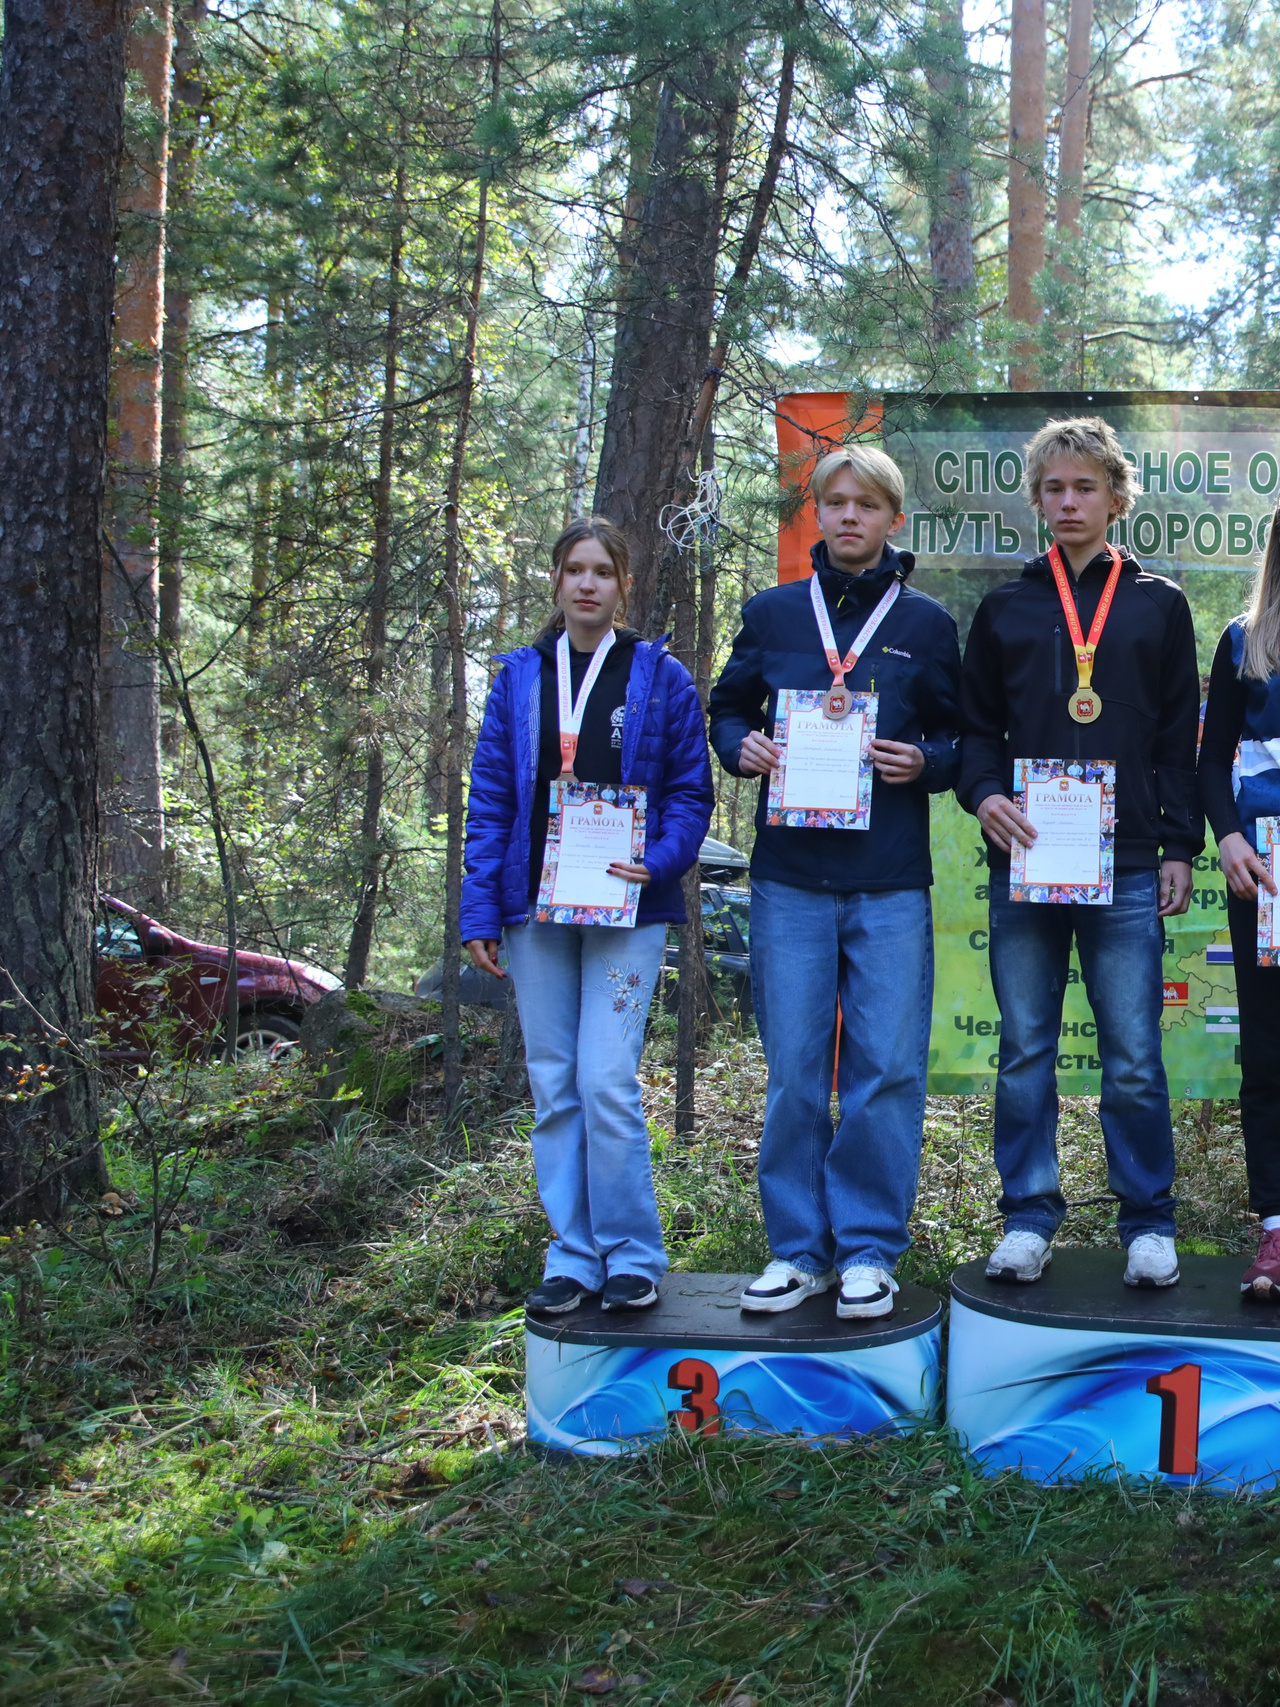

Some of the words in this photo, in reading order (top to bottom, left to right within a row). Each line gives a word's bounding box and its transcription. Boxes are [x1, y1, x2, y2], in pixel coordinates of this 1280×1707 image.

[933, 450, 1231, 495] СПОНОЕ
[911, 511, 1021, 555] ПУТЬ
[797, 720, 854, 731] ГРАМОТА
[1035, 793, 1093, 803] ГРАМОТА
[570, 816, 625, 828] ГРАМОТА
[668, 1357, 720, 1436] 3
[1146, 1362, 1202, 1475] 1
